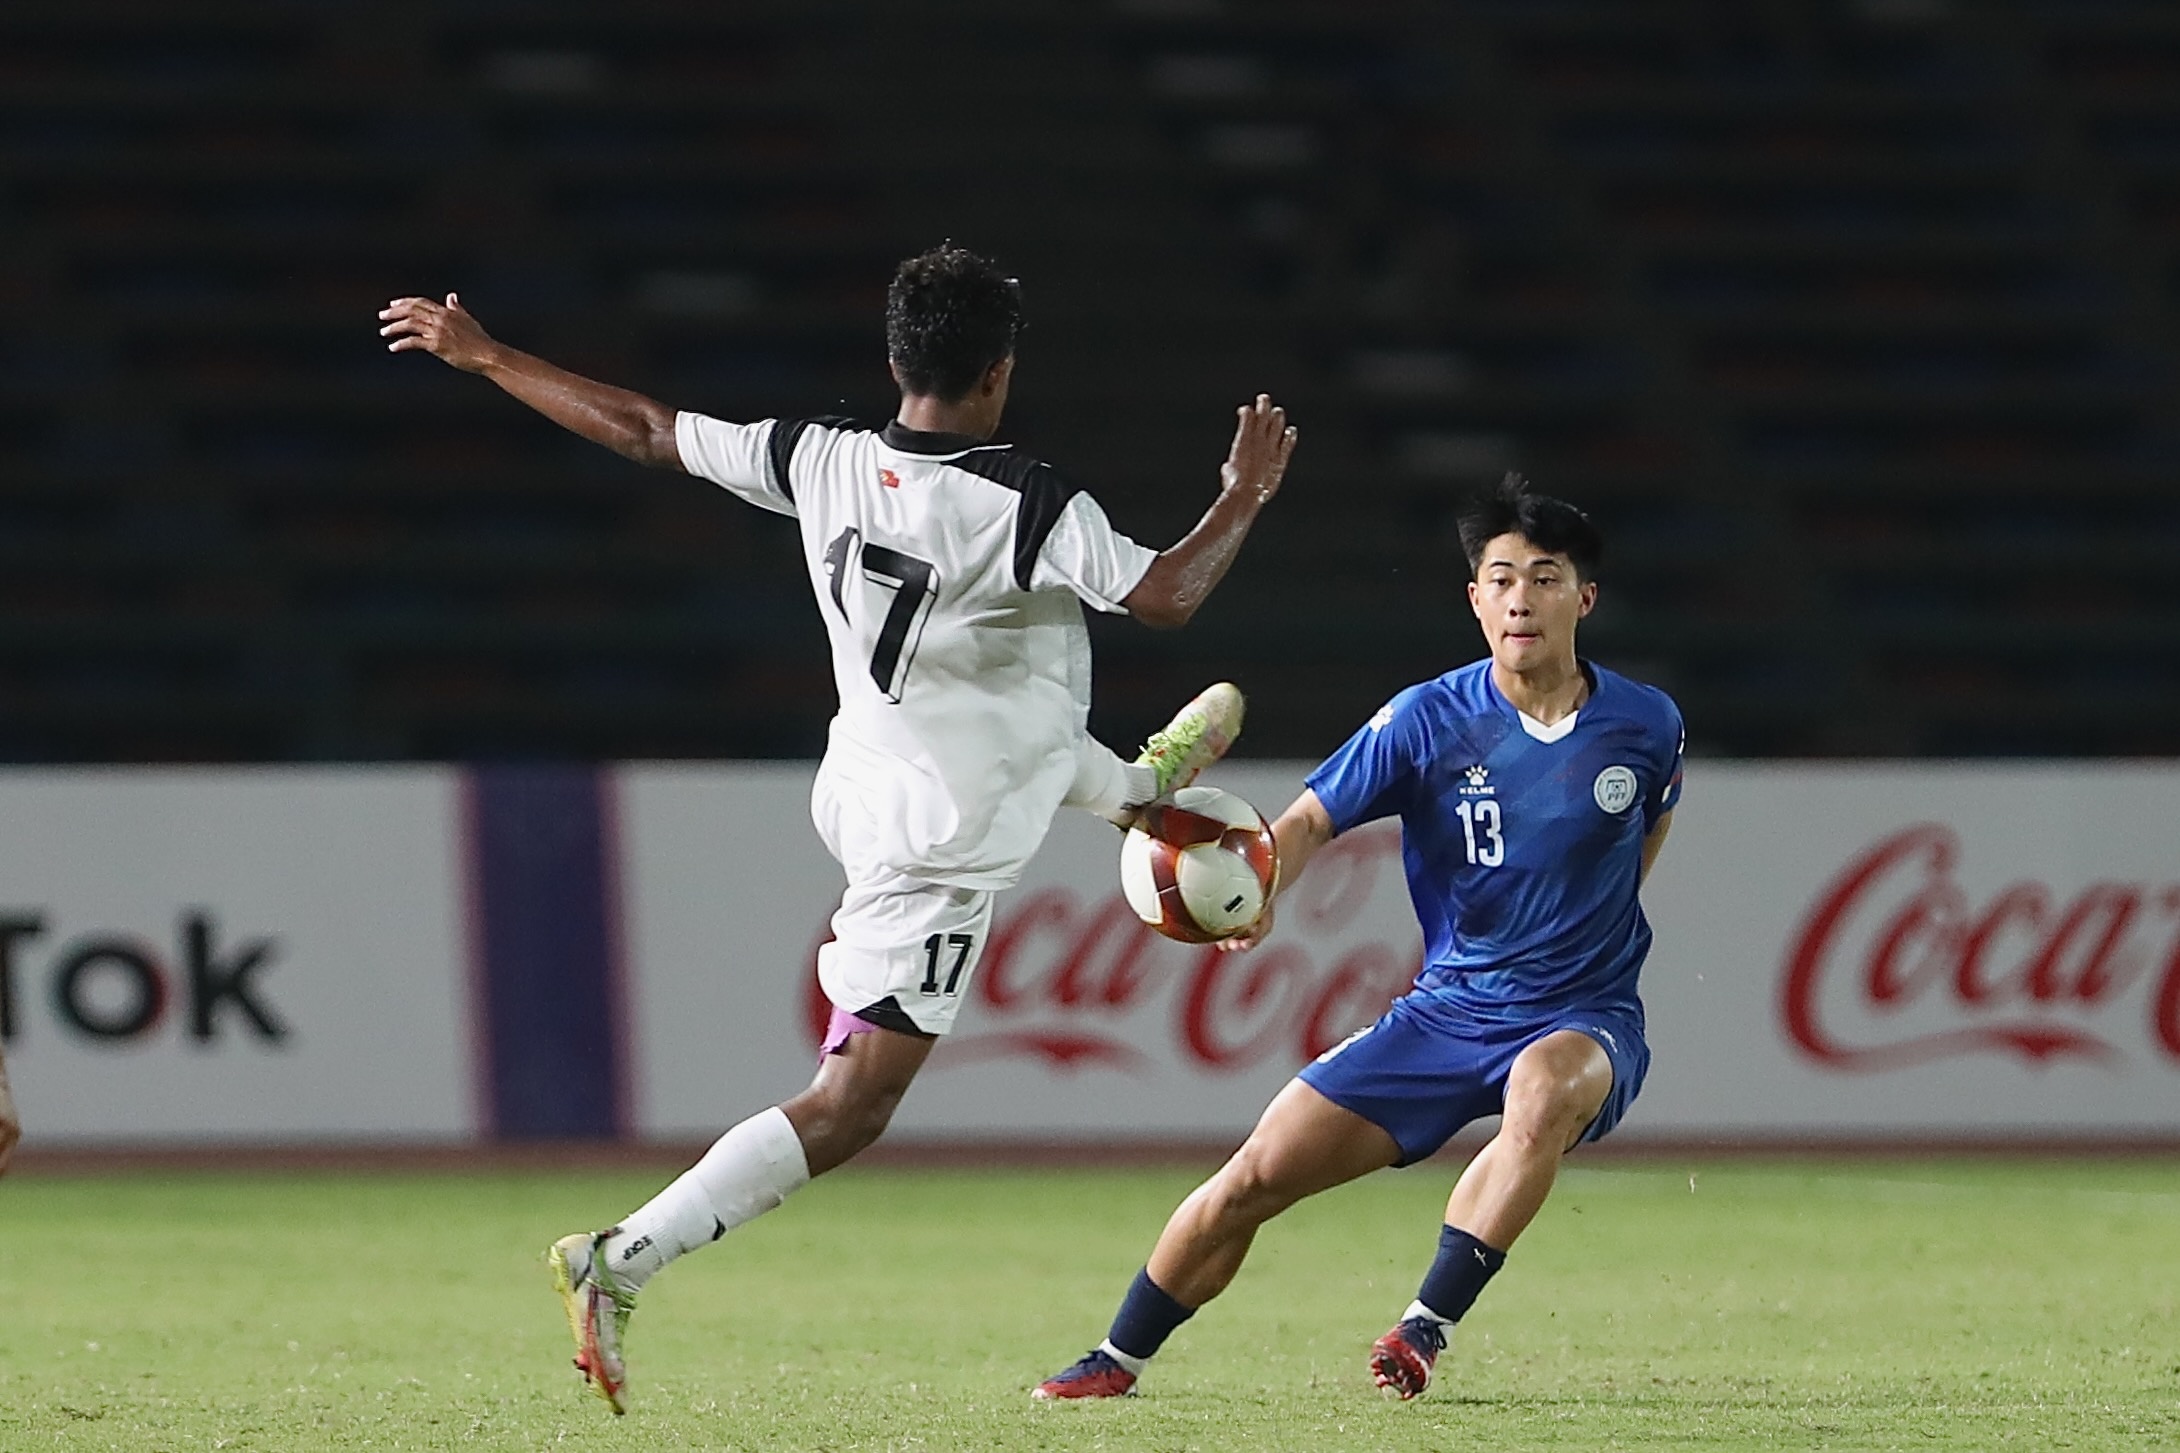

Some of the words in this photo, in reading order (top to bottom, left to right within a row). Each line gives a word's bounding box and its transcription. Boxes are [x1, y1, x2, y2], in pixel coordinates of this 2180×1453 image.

[823, 526, 940, 705] 17
[1459, 785, 1496, 796] KELME
[1454, 799, 1505, 868] 13
[921, 933, 974, 998] 17
